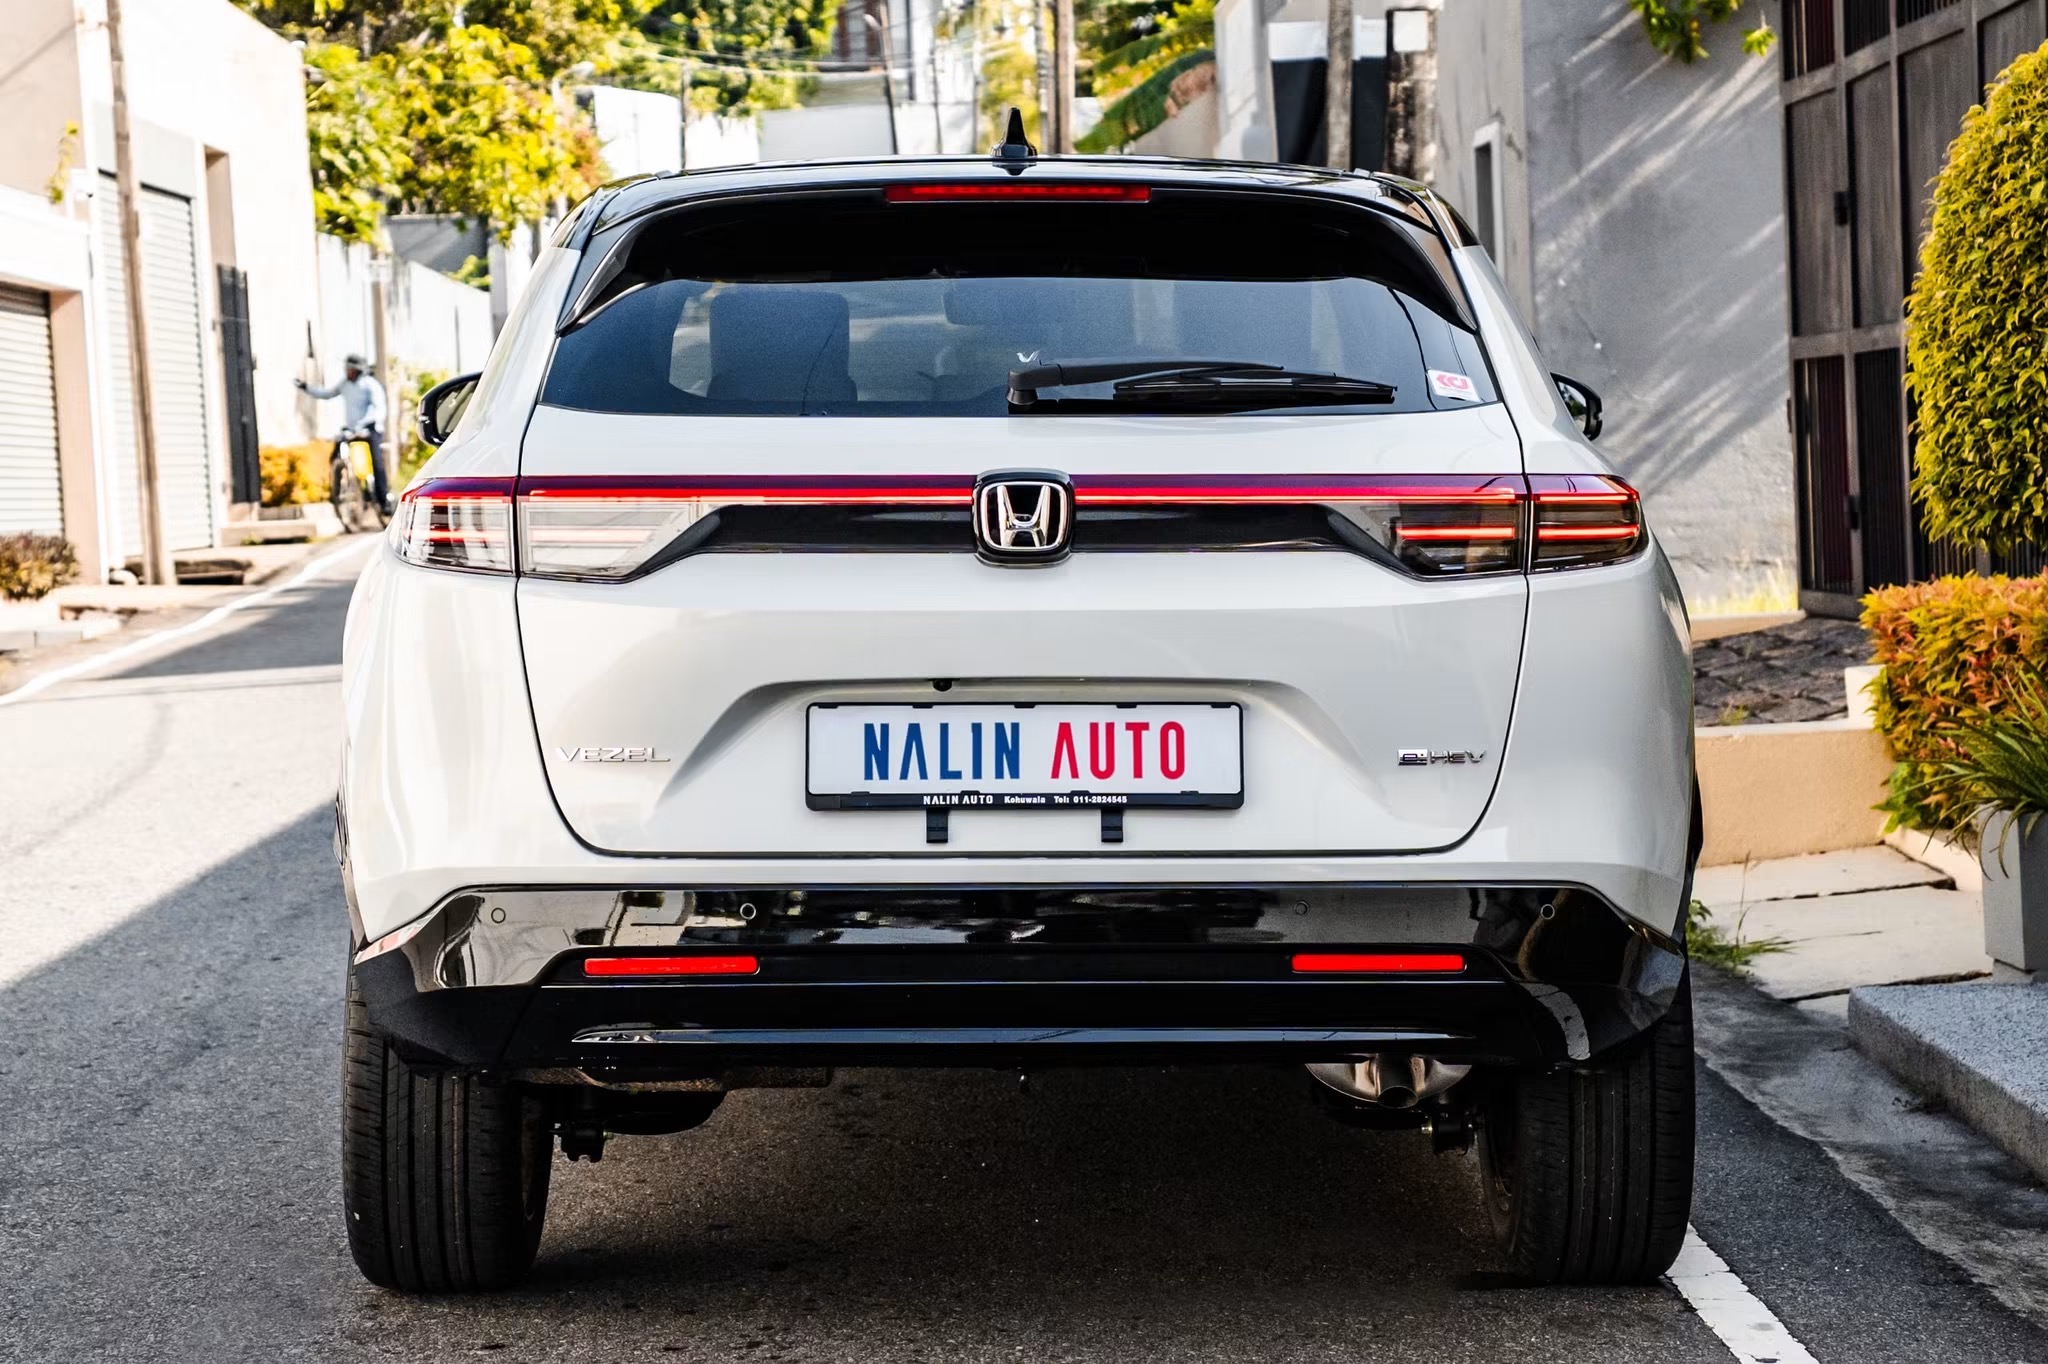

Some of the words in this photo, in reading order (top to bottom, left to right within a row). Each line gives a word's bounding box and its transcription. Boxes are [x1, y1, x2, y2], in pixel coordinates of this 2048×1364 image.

[555, 747, 671, 763] VEZEL
[863, 721, 1020, 781] NALIN
[1050, 720, 1185, 780] AUTO
[923, 795, 959, 805] NALIN
[962, 795, 994, 805] AUTO
[1004, 795, 1046, 804] Kohuwala
[1053, 795, 1070, 804] Tel:
[1073, 795, 1128, 804] 011-2824545
